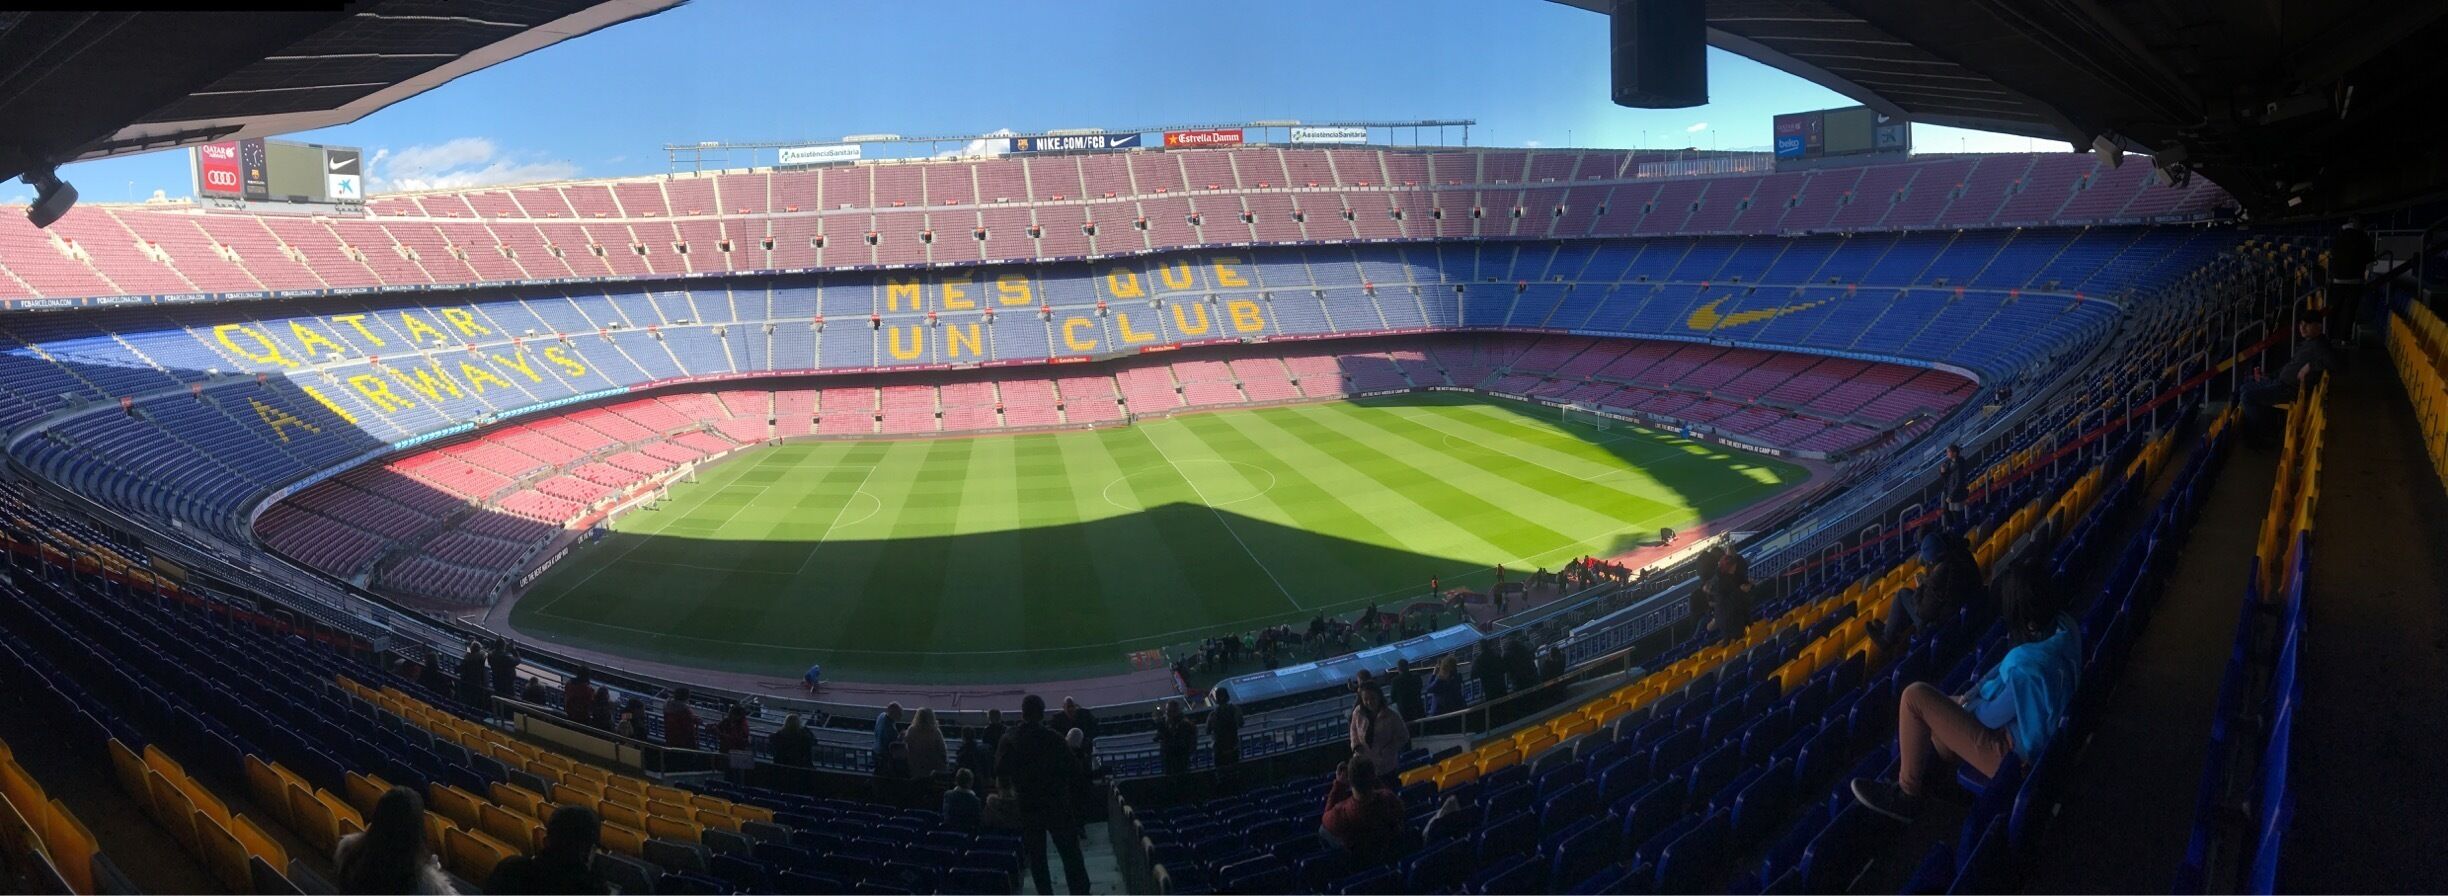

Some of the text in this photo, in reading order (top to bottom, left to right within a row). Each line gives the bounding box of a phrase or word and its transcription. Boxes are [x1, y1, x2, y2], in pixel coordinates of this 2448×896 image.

[1036, 135, 1105, 150] NIKE.COM/FCB
[1178, 131, 1240, 144] Estrella Damm
[1779, 138, 1799, 149] beko
[203, 145, 226, 154] QATAR
[1108, 257, 1248, 299] QUE
[21, 299, 72, 308] FCBARCELONA.COM
[96, 296, 142, 305] FCBARCELONA.COM
[888, 300, 1266, 360] UN CLUB
[213, 307, 491, 368] QATAR
[248, 346, 587, 443] AIRWAYS
